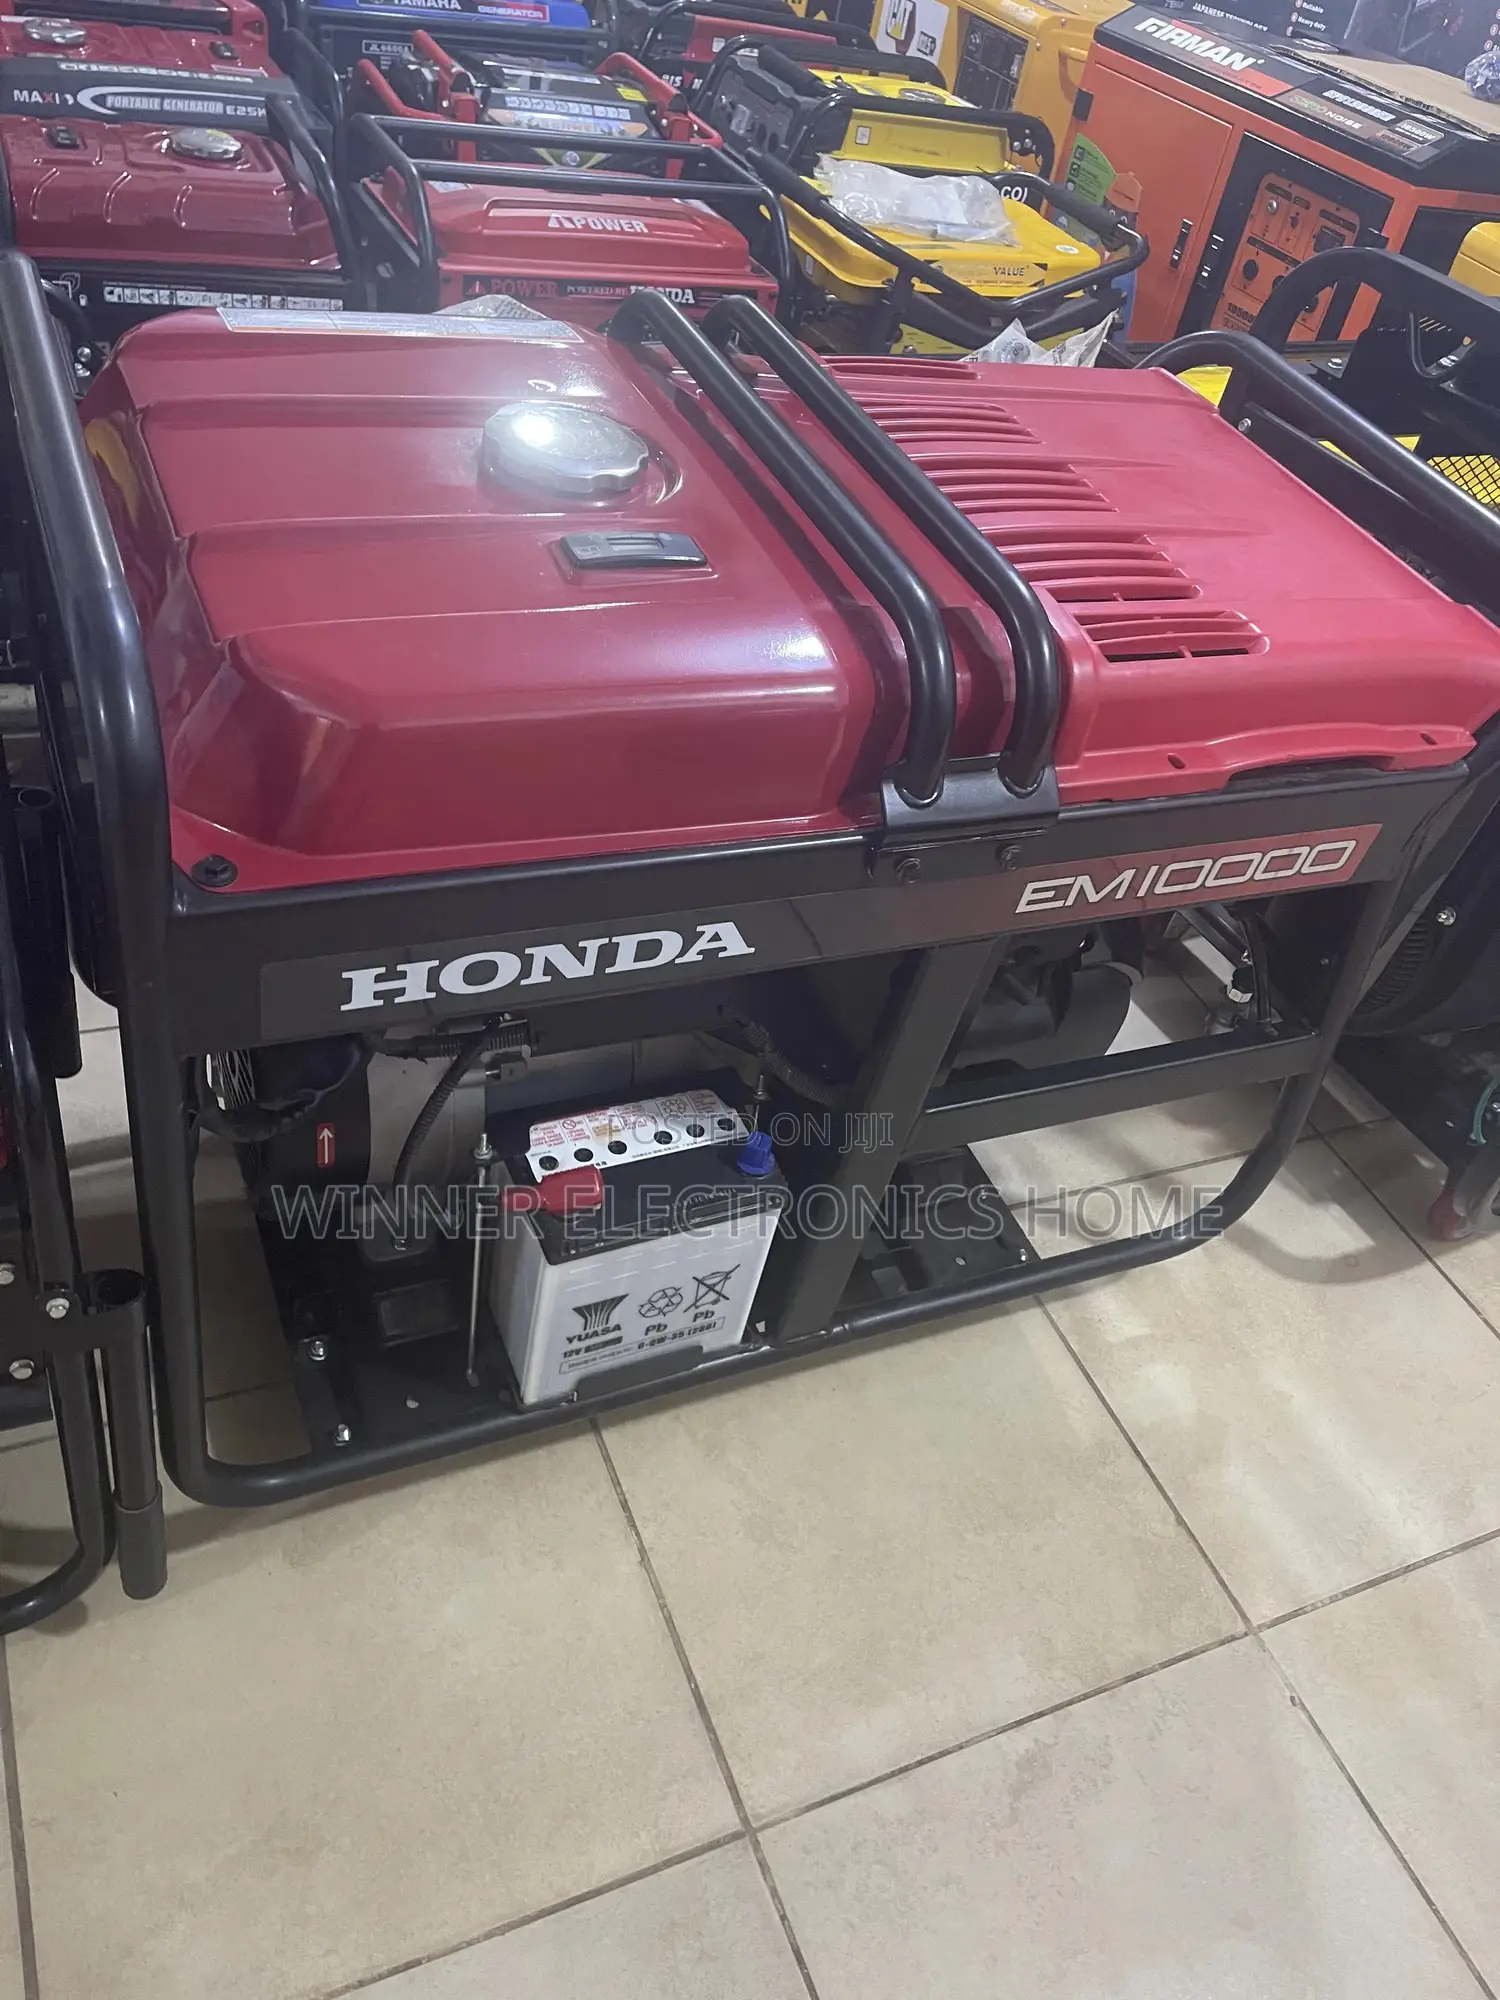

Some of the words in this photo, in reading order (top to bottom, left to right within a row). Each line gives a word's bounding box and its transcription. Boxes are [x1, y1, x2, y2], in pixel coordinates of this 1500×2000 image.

[477, 5, 544, 18] GENERATOR
[1134, 17, 1257, 71] FIRMAN
[13, 89, 60, 105] MAXI
[106, 95, 161, 110] PORTABLE
[163, 97, 223, 114] GENERATOR
[1325, 111, 1363, 129] NOISE
[993, 266, 1025, 276] VALUE
[490, 280, 558, 297] POWER
[1015, 839, 1357, 913] EM10000
[340, 921, 756, 1011] HONDA
[693, 1310, 715, 1323] Pb
[566, 1324, 622, 1344] YUASA
[644, 1323, 668, 1336] Pb
